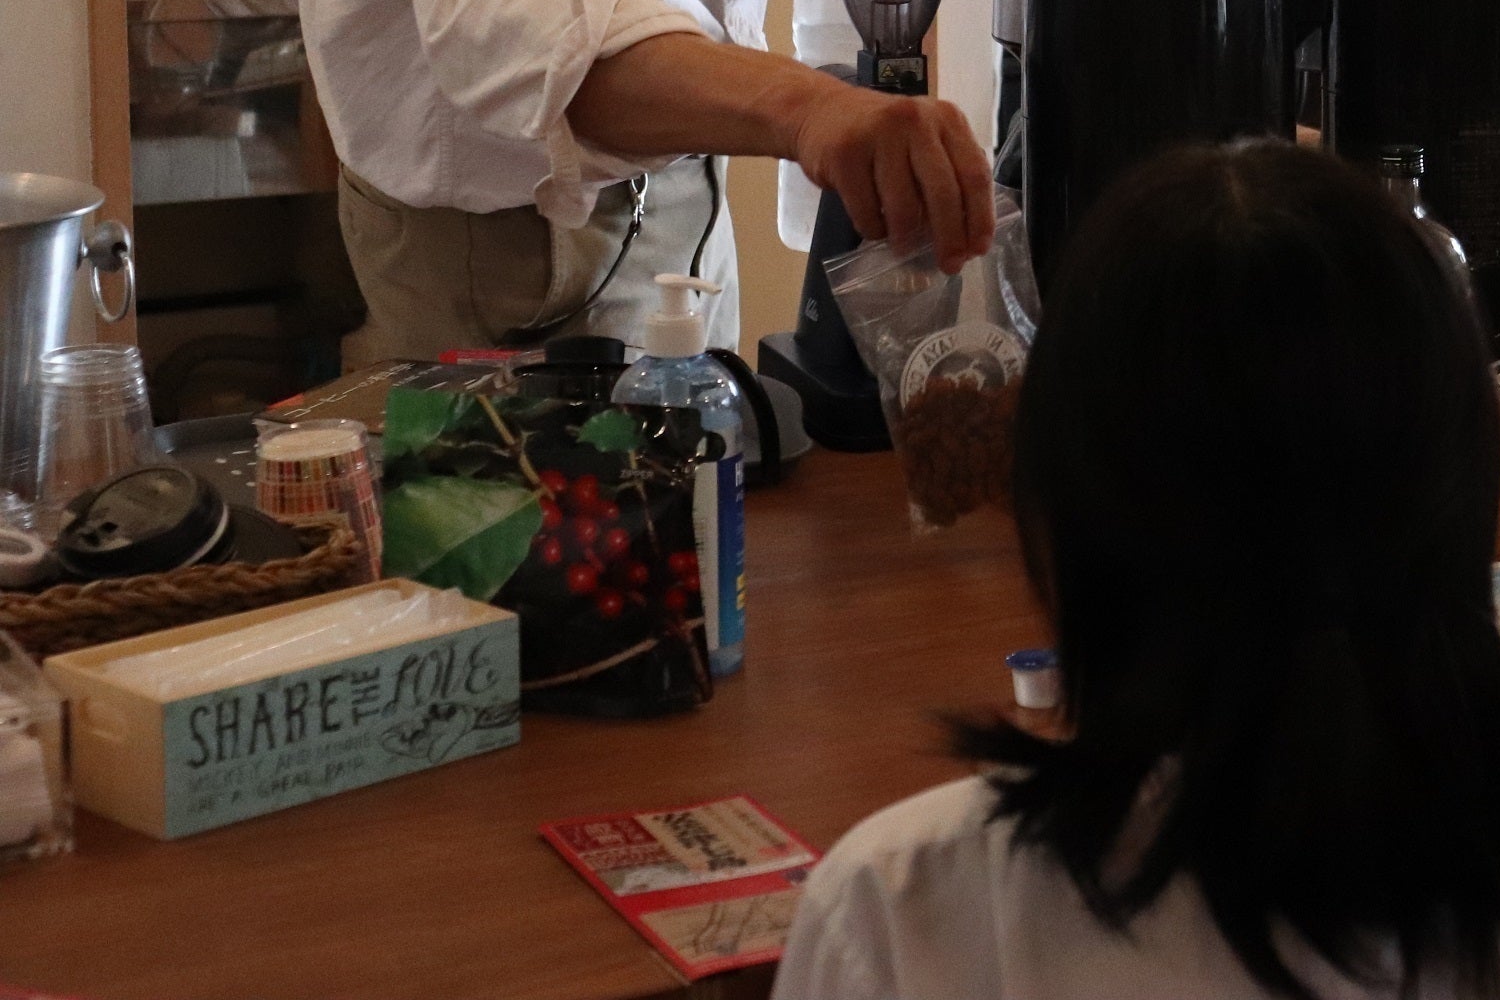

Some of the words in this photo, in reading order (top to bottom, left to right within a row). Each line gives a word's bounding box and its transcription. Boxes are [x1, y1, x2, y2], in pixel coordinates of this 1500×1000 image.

[187, 673, 344, 769] SHARE
[351, 665, 380, 727] THE
[380, 637, 498, 718] LOVE
